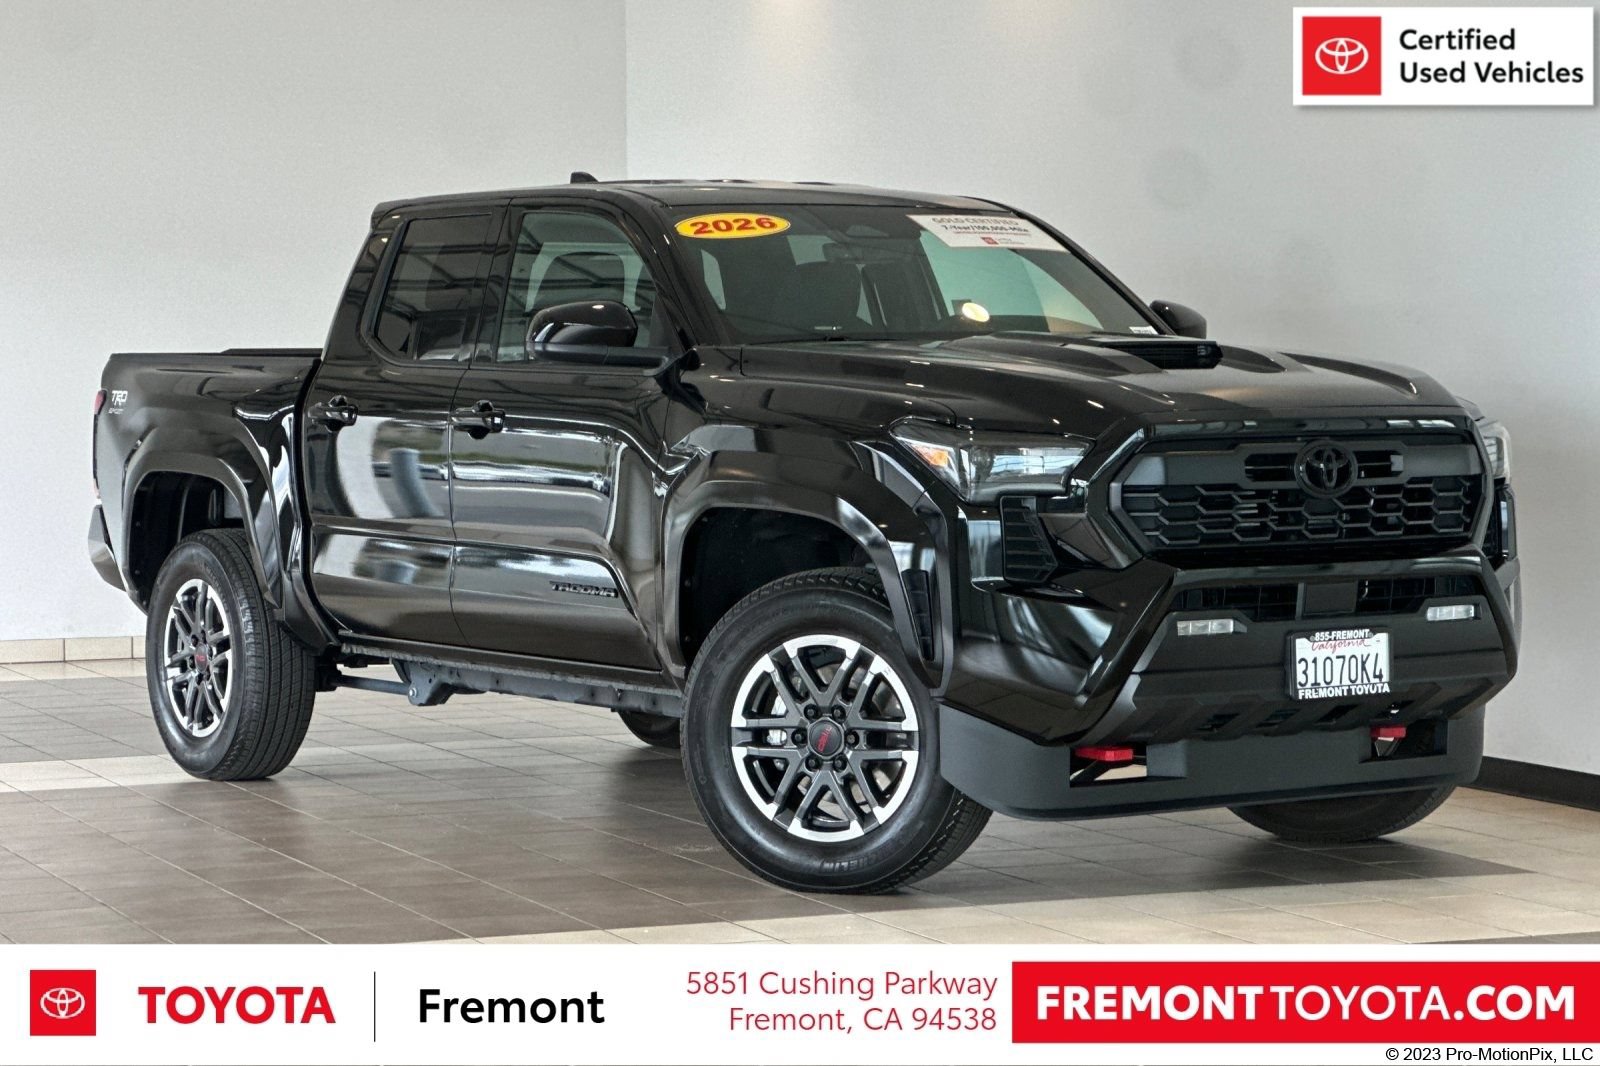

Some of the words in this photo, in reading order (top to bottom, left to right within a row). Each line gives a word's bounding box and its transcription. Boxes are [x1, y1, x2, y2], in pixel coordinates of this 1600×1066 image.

[690, 217, 777, 235] 2026
[111, 390, 128, 406] TRD
[549, 581, 618, 598] TACOMA
[1315, 629, 1370, 641] 855-FREMONT
[1311, 639, 1372, 654] California
[1298, 652, 1384, 688] 31070K4
[1298, 685, 1349, 700] FREMONT
